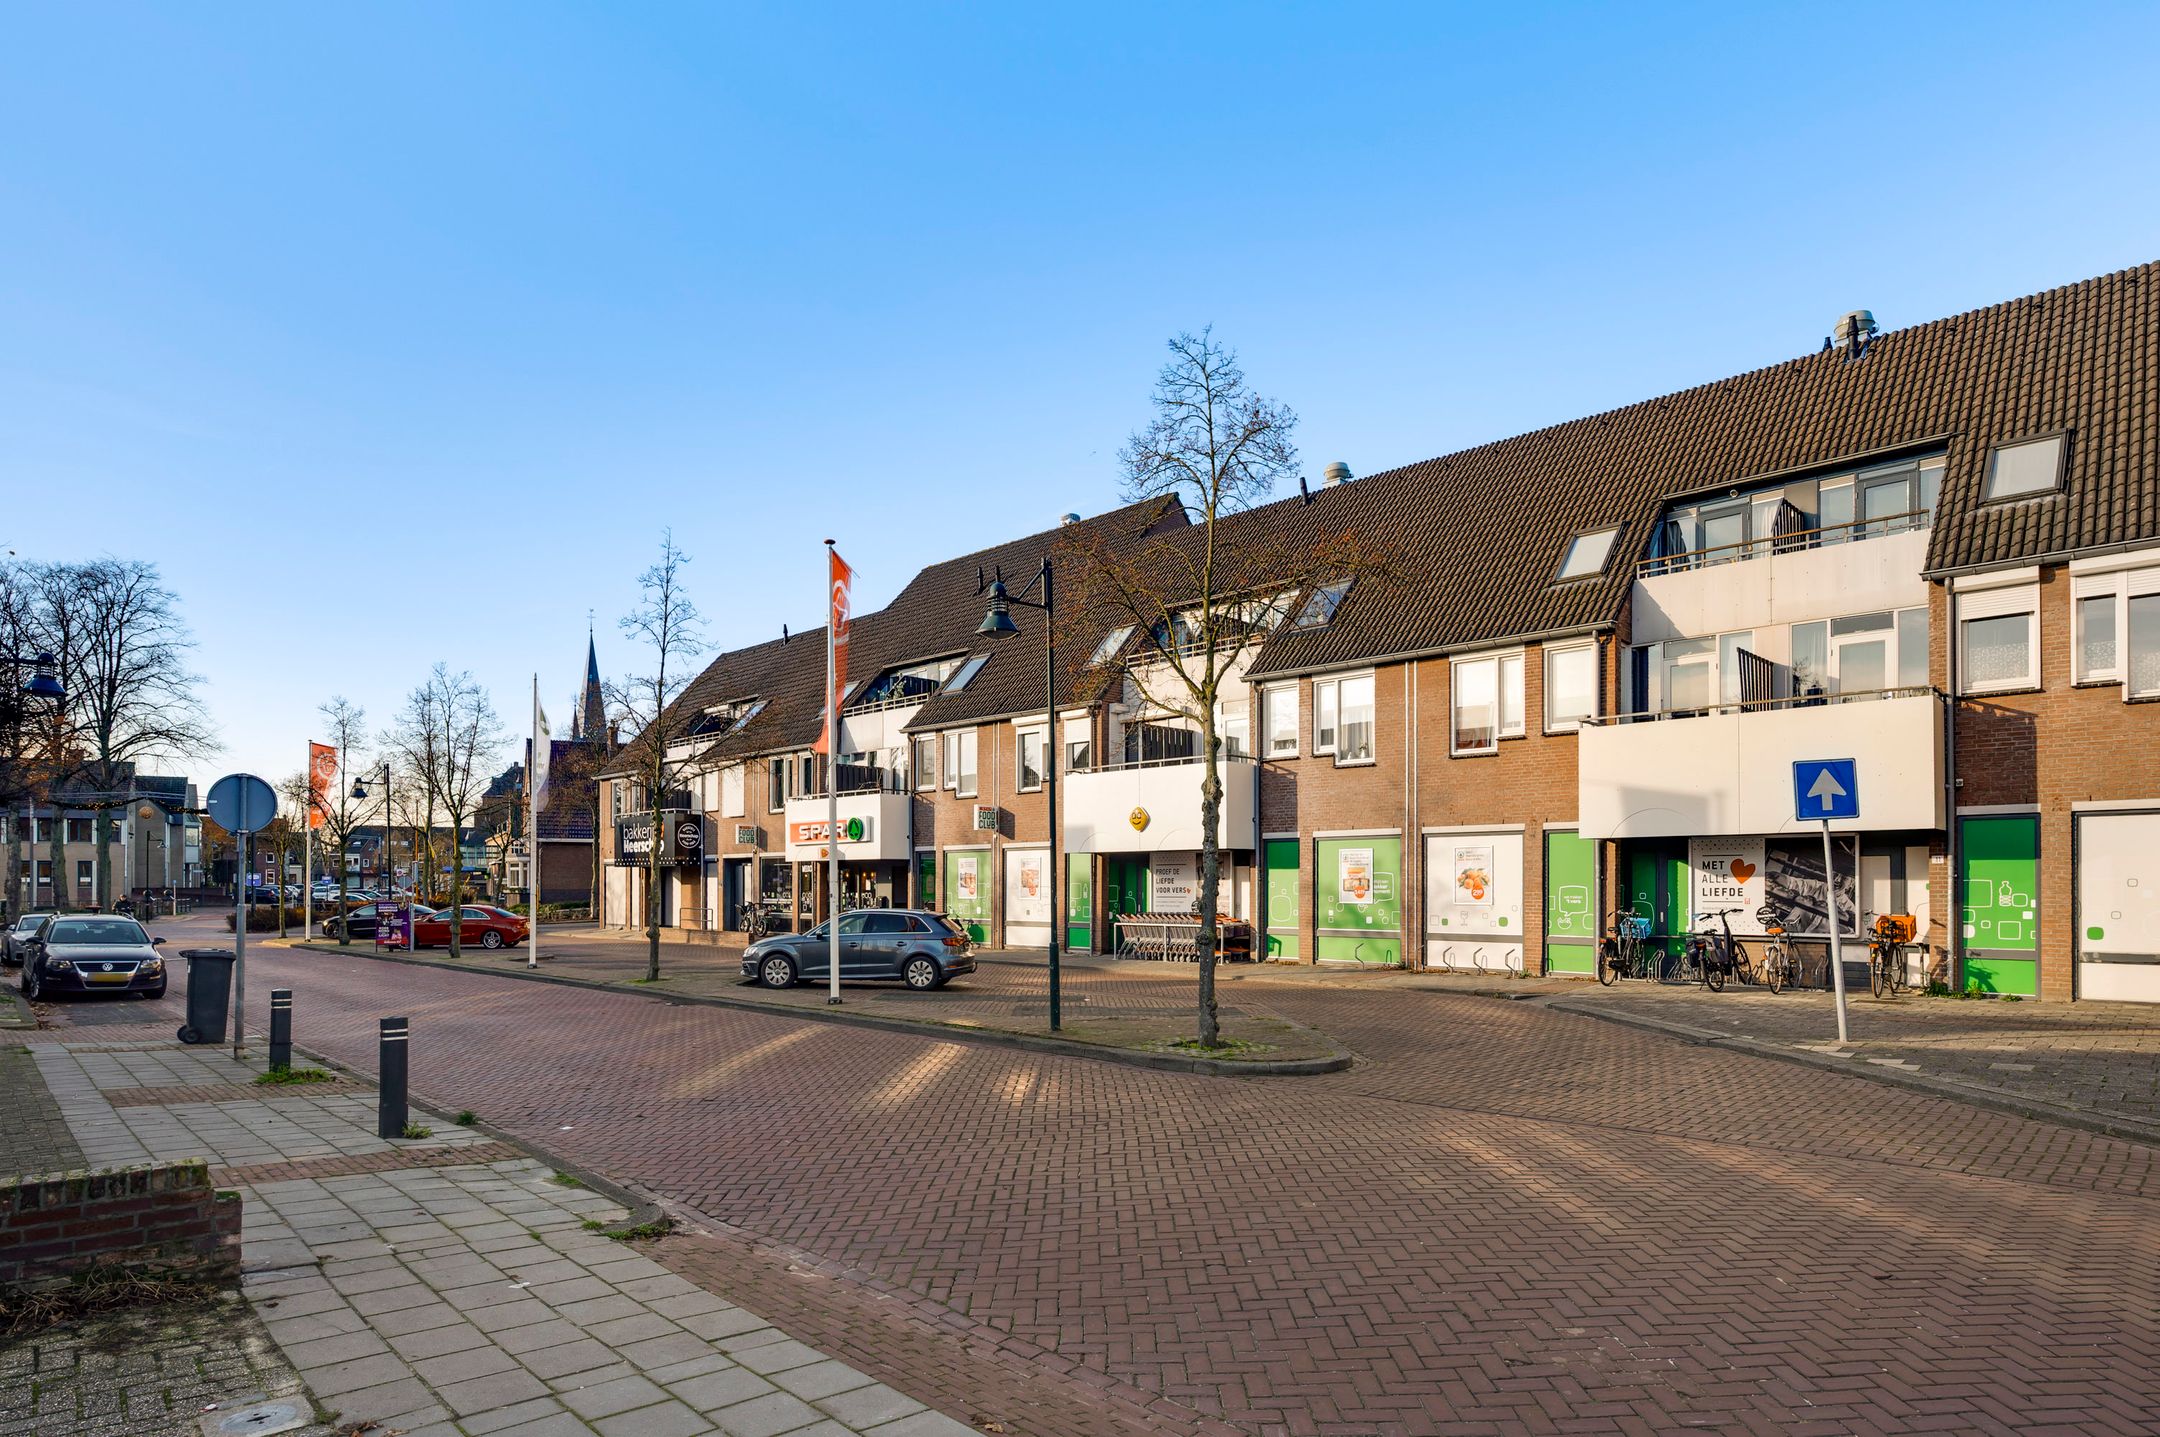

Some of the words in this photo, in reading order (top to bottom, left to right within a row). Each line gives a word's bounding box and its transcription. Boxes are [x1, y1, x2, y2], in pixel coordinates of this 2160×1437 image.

[979, 811, 995, 820] FOOD
[979, 820, 995, 829] CLUB
[799, 823, 846, 840] SPAR
[623, 838, 665, 855] Heerschp
[1702, 861, 1725, 870] MET
[1702, 874, 1728, 883] ALLE
[1702, 887, 1744, 897] LIEFDE
